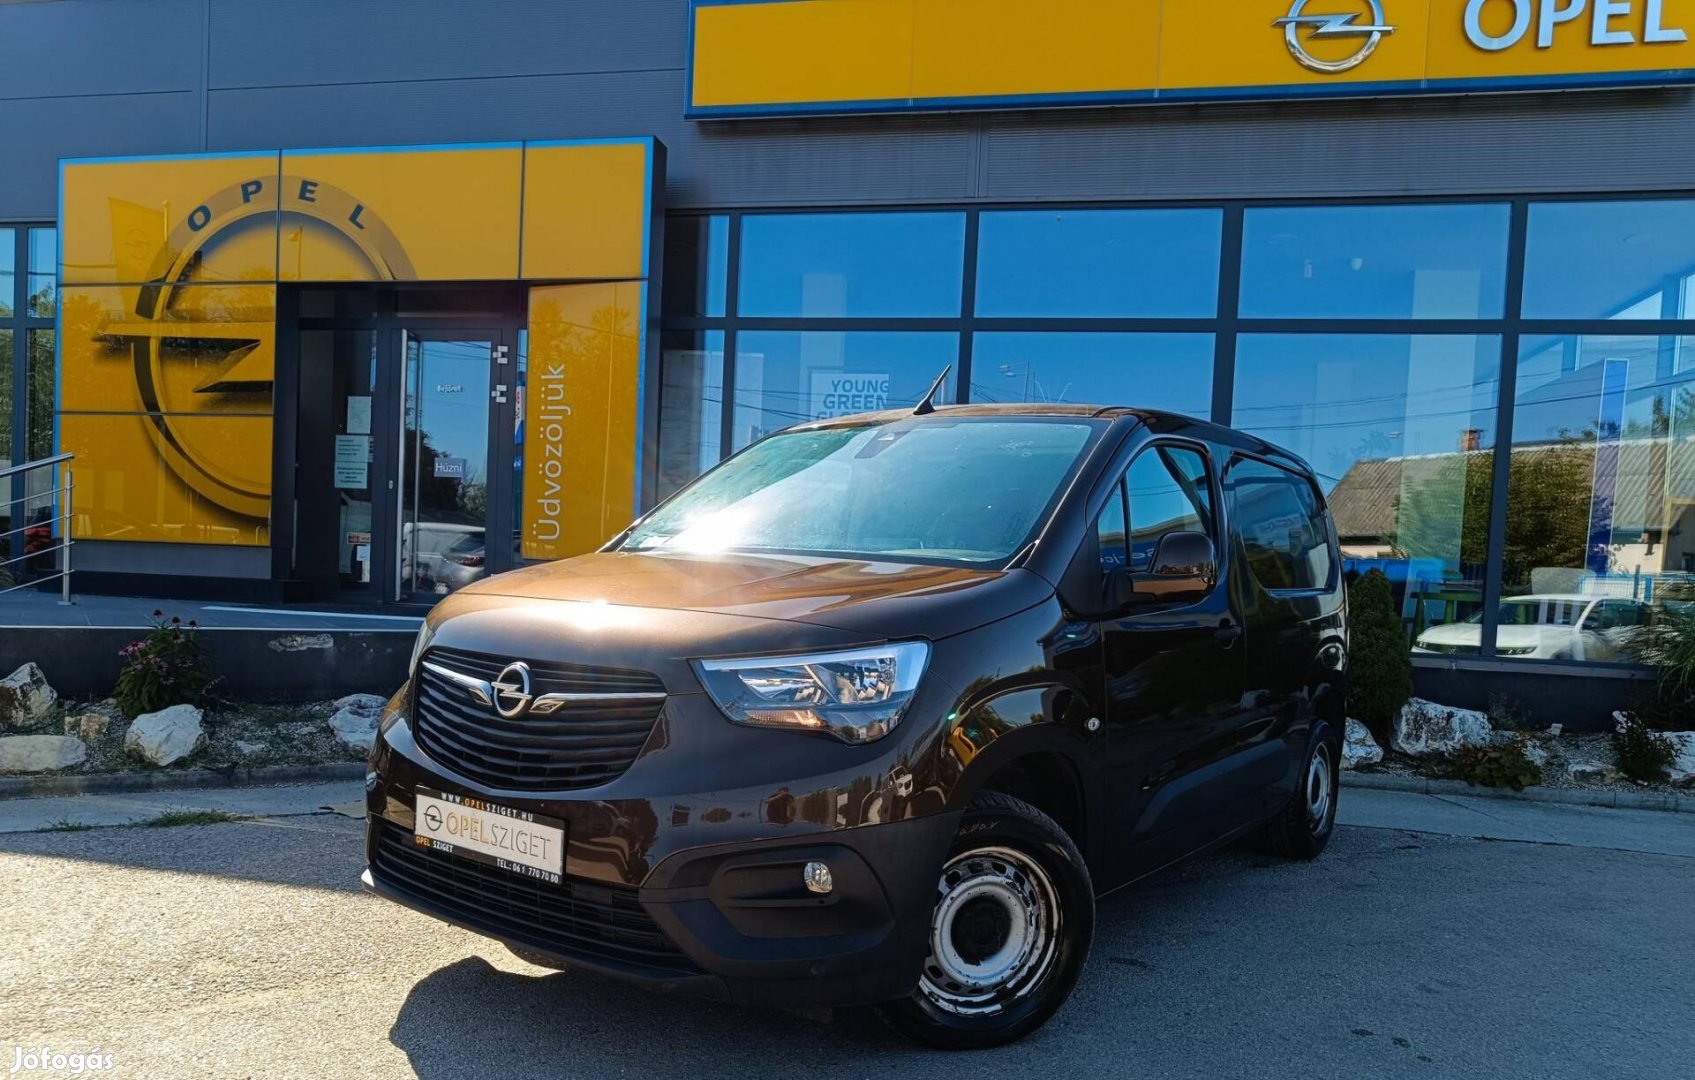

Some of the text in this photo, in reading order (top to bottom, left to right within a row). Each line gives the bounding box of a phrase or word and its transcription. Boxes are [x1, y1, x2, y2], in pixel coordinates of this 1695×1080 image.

[1463, 0, 1688, 51] OPEL
[187, 180, 366, 232] OPEL
[831, 379, 889, 393] YOUNG
[532, 363, 571, 541] Üdvözöljük
[415, 835, 453, 853] OPEL SZIGET
